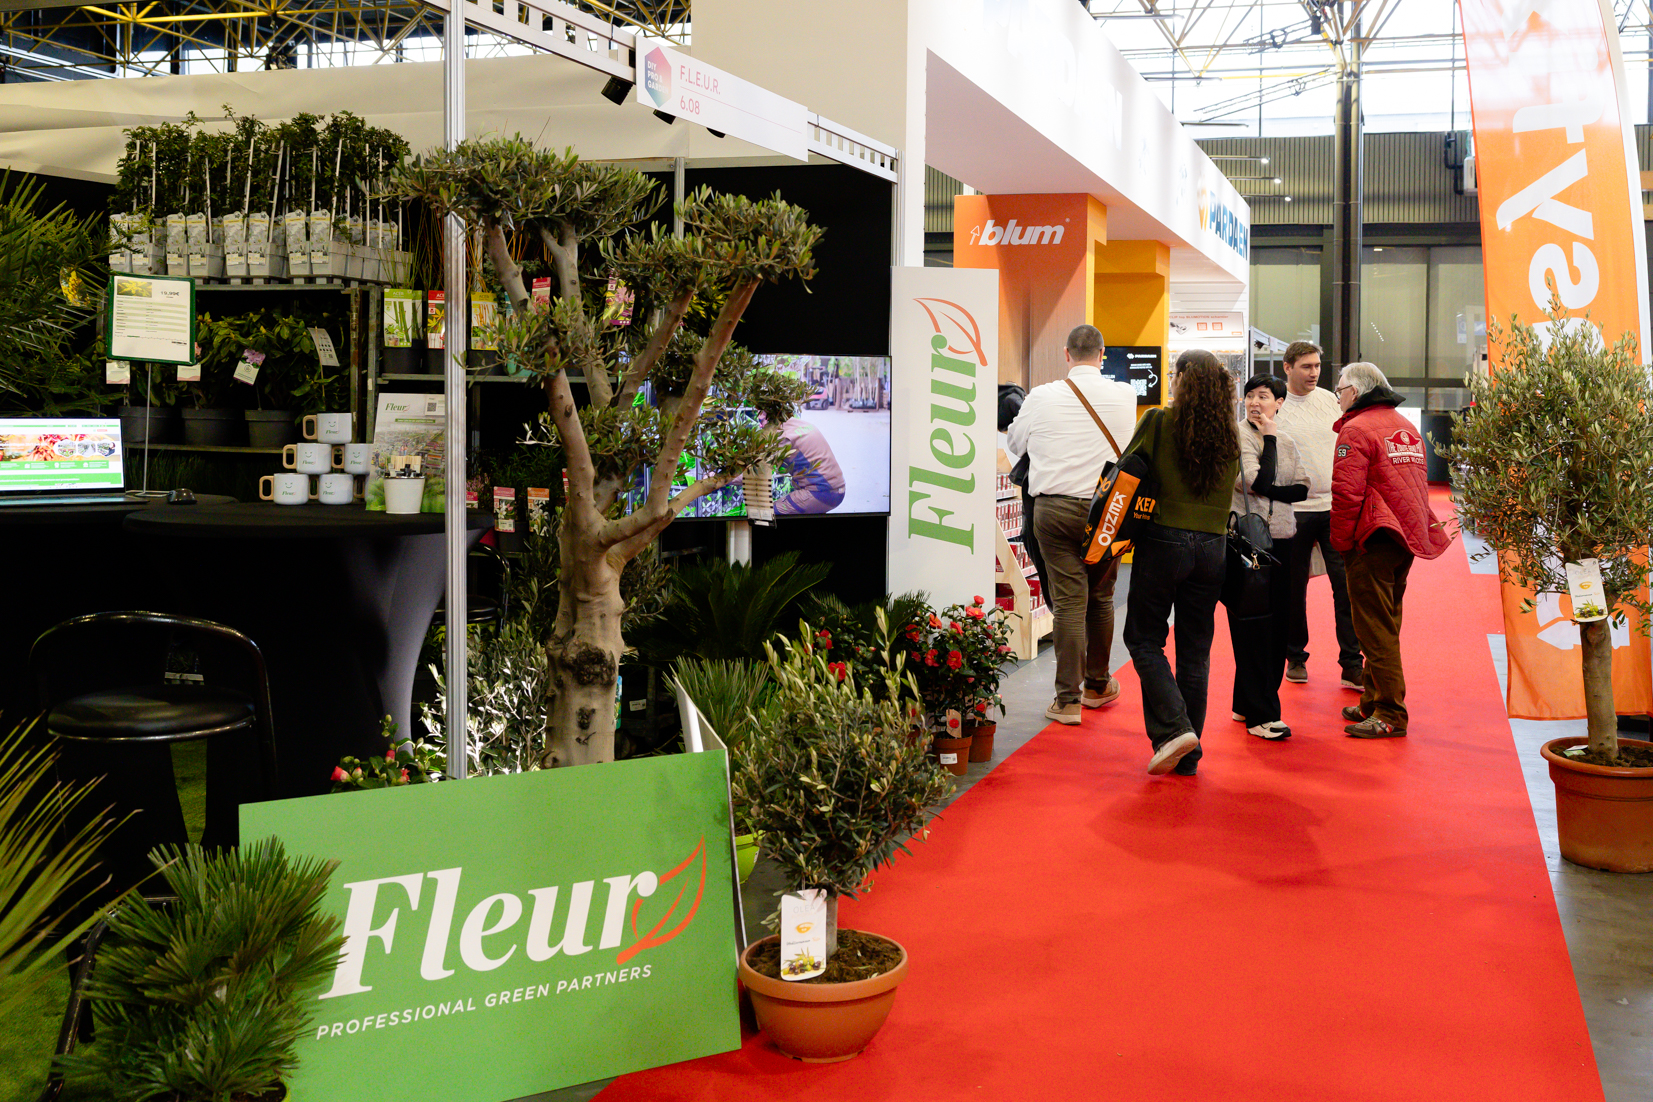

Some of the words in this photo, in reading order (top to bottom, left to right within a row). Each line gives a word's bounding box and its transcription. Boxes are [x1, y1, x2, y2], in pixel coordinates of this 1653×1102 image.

[648, 61, 657, 70] DIY
[648, 70, 658, 80] PRO
[648, 80, 669, 94] GARDEN
[680, 65, 720, 95] F.L.E.U.R.
[680, 96, 700, 115] 6.08
[978, 219, 1064, 246] blum
[1209, 190, 1248, 261] PARDAEN
[385, 403, 407, 411] Fleur
[908, 334, 976, 555] Fleur
[1098, 491, 1127, 546] KENDO
[793, 905, 815, 914] OLEA
[318, 867, 658, 1000] Fleur
[316, 998, 476, 1040] PROFESSIONAL
[485, 983, 549, 1007] GREEN
[556, 965, 652, 994] PARTNERS
